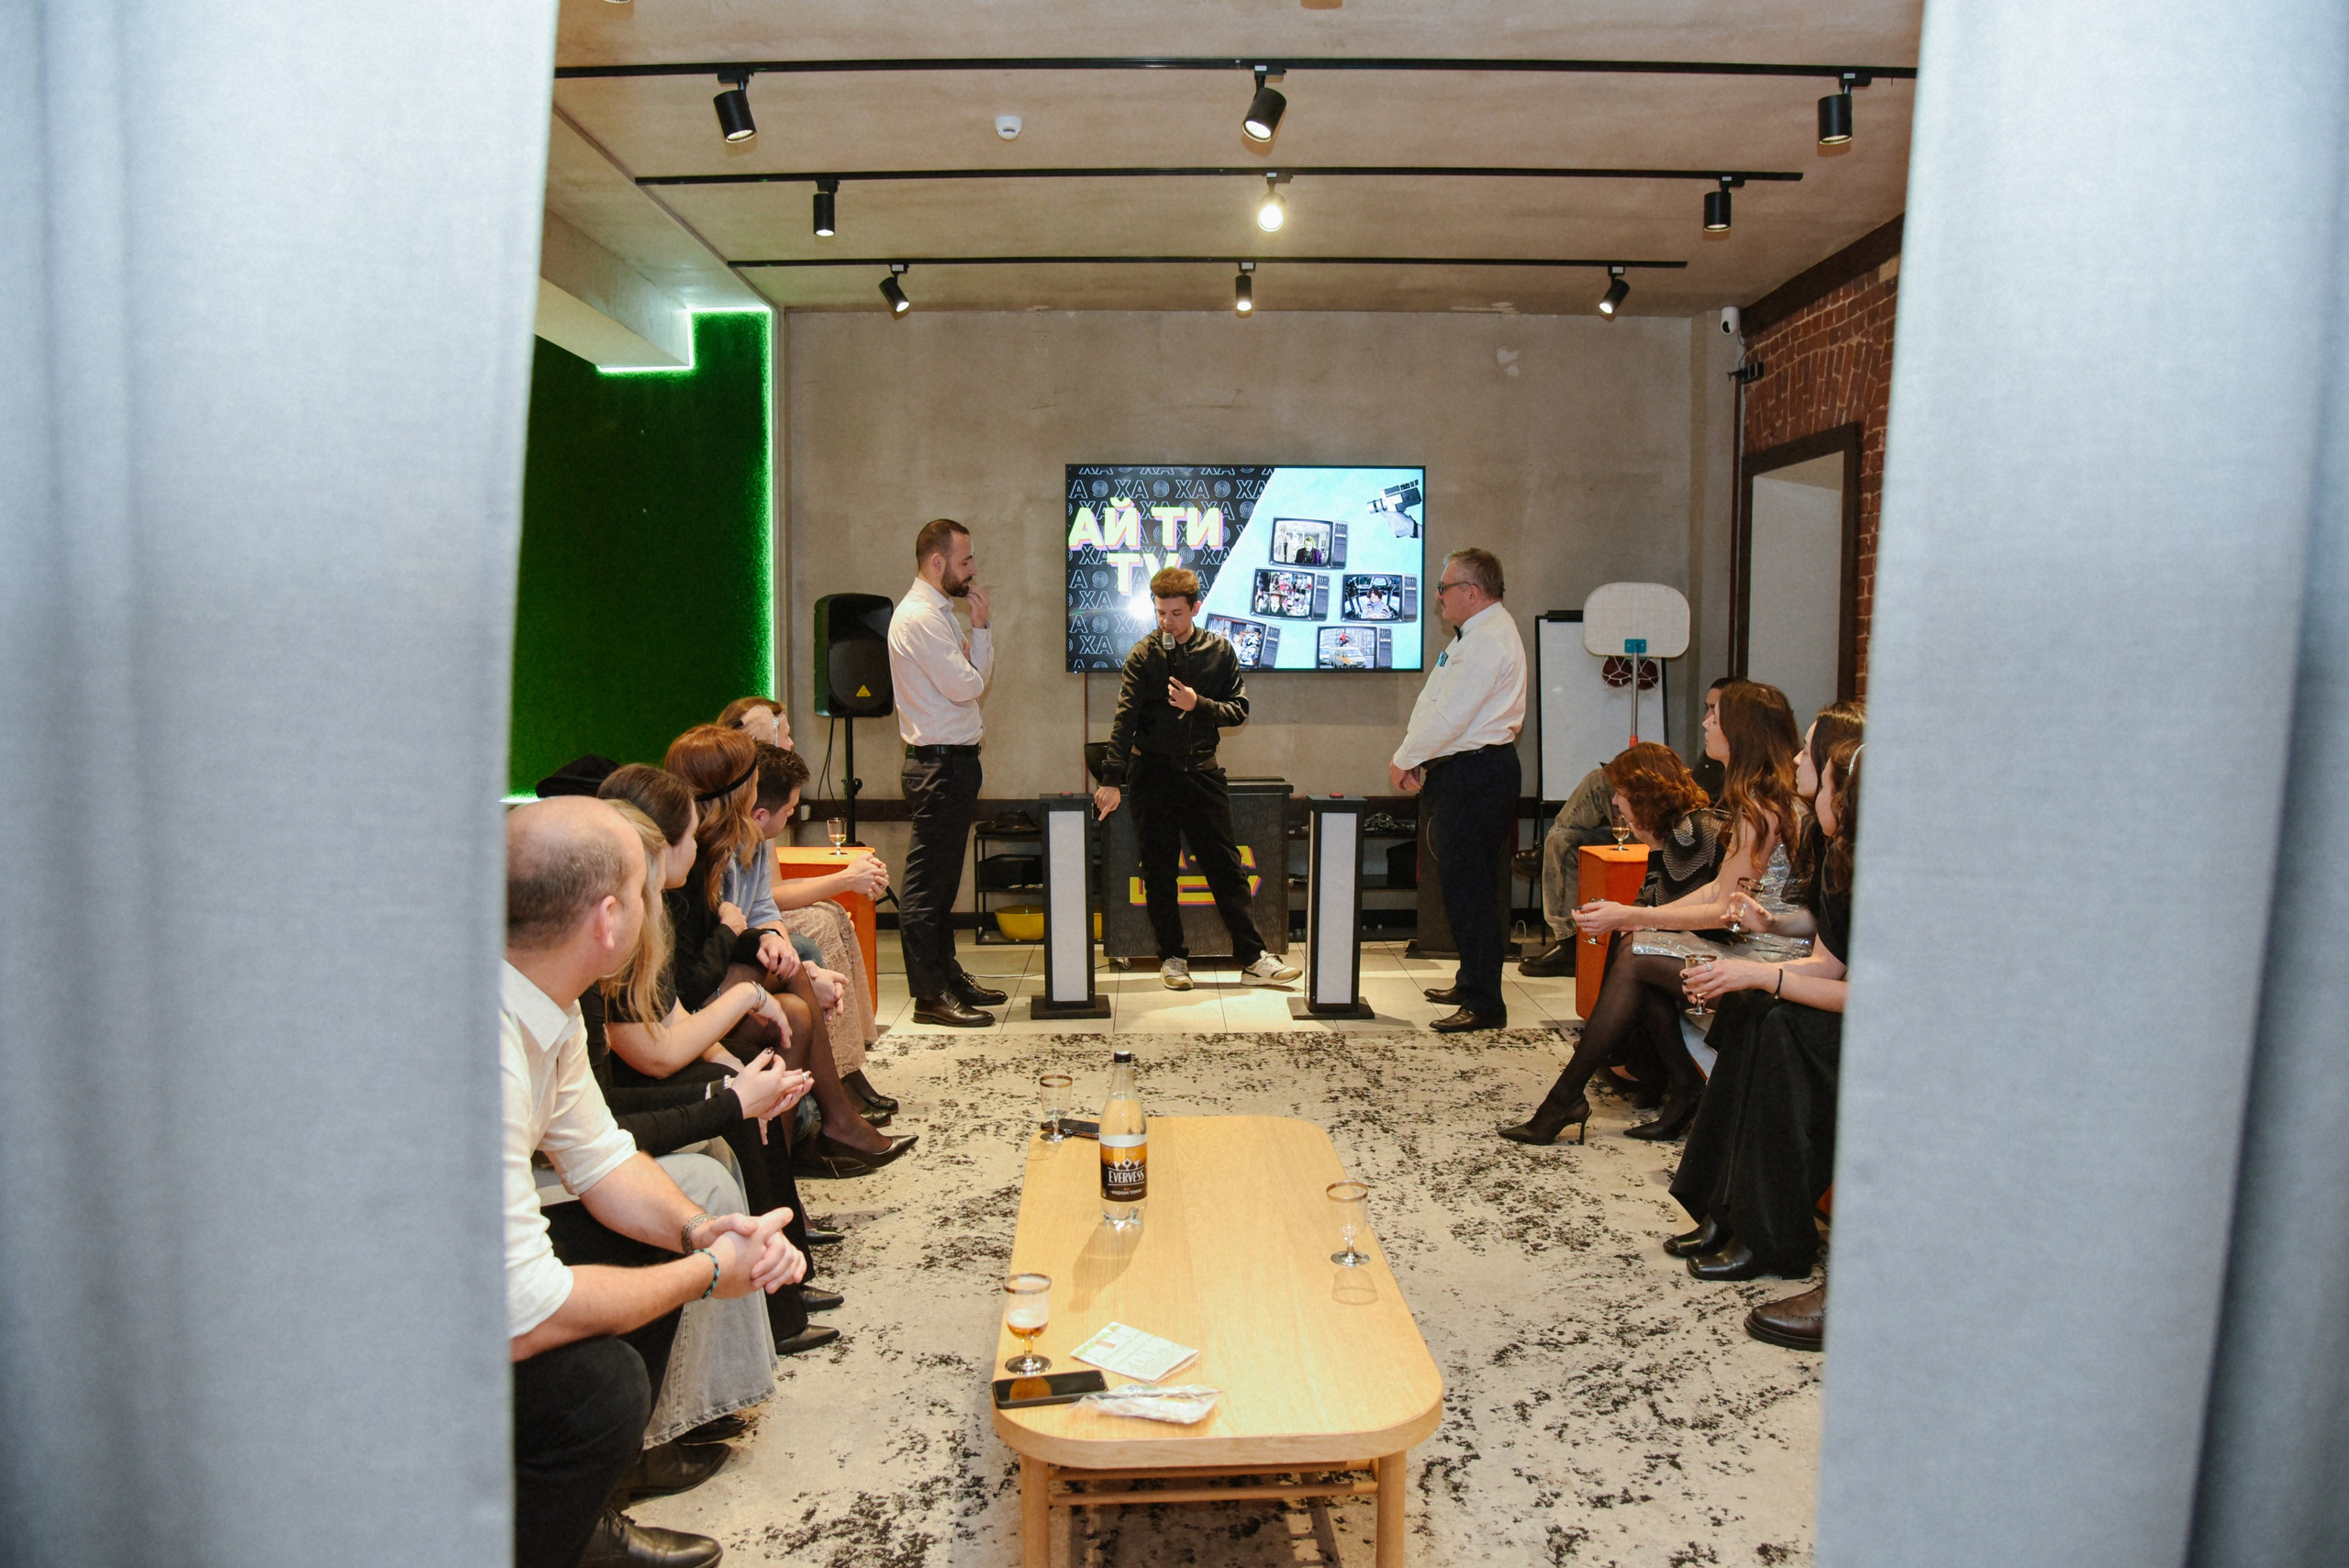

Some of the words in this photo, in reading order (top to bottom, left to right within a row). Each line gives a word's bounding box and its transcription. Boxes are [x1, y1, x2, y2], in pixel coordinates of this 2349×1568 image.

[1068, 497, 1141, 550] АЙ
[1151, 507, 1223, 550] ТИ
[1108, 1168, 1145, 1184] EVERVESS
